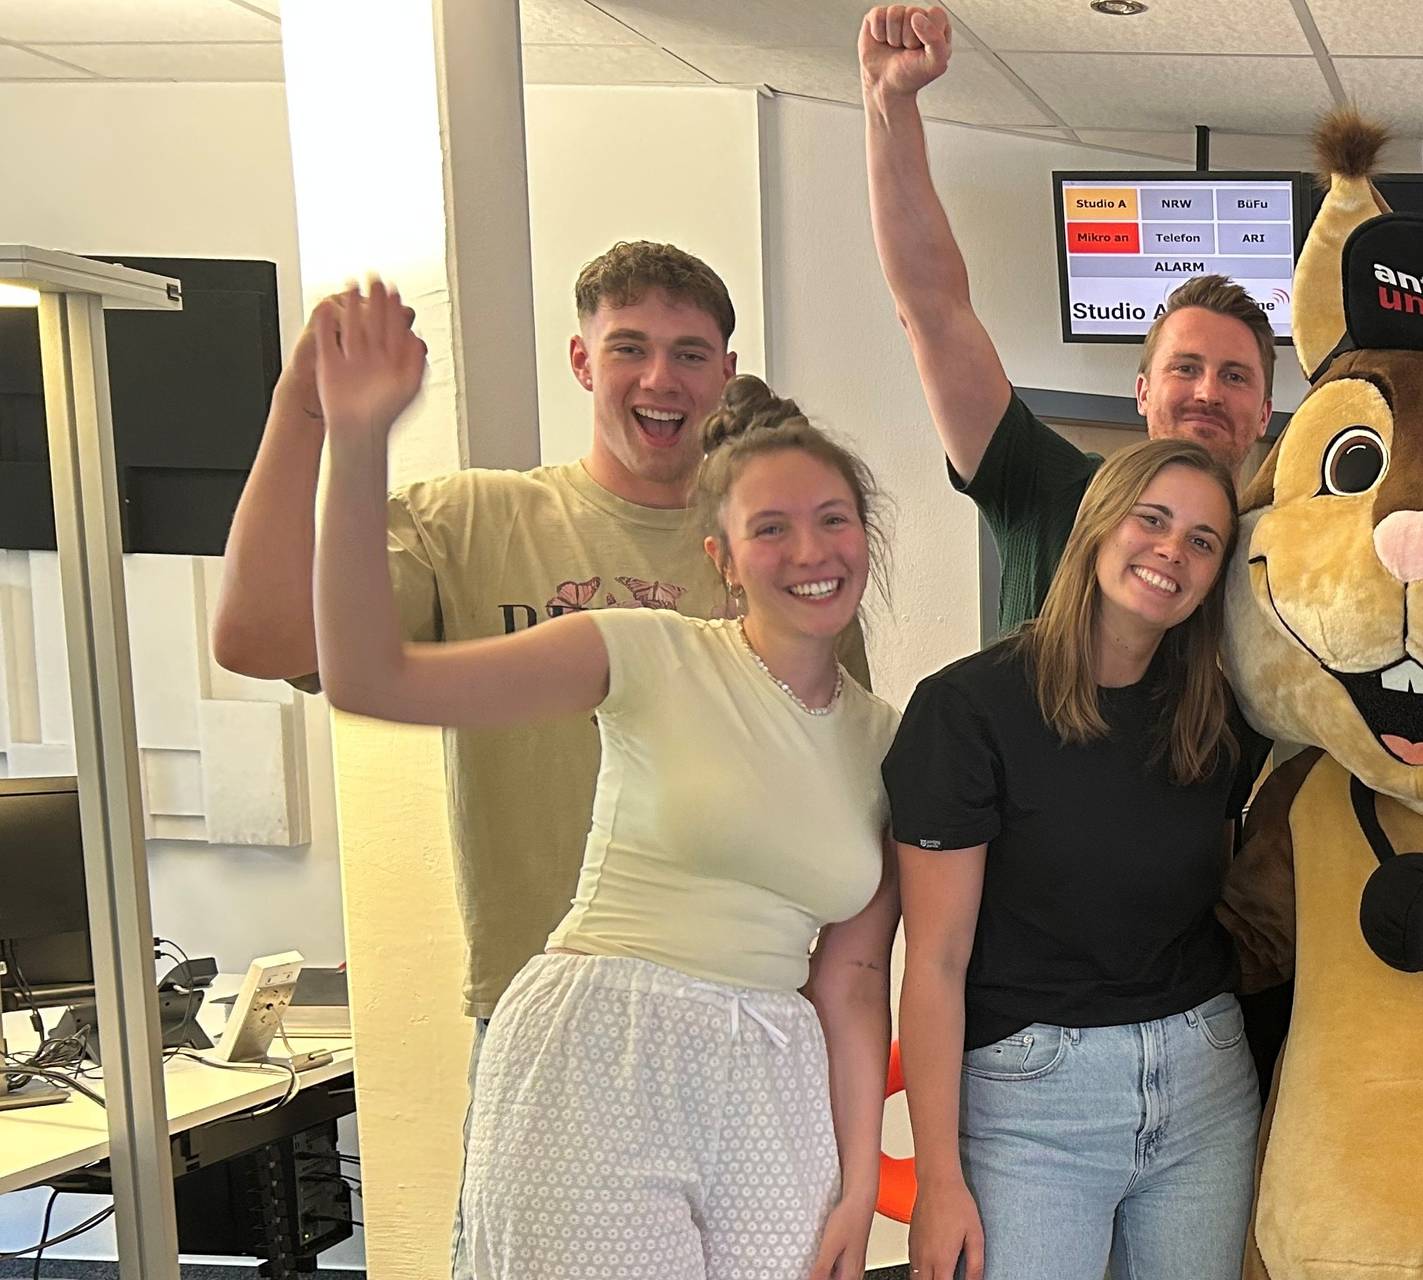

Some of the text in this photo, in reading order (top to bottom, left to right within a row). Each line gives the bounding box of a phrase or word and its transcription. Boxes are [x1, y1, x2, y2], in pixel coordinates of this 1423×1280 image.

[1076, 199, 1127, 208] Studio A
[1161, 199, 1192, 208] NRW
[1237, 199, 1268, 208] BüFu
[1077, 232, 1129, 242] Mikro an
[1156, 233, 1201, 242] Telefon
[1242, 234, 1265, 243] ARI
[1154, 262, 1205, 272] ALARM
[1073, 302, 1146, 320] Studio
